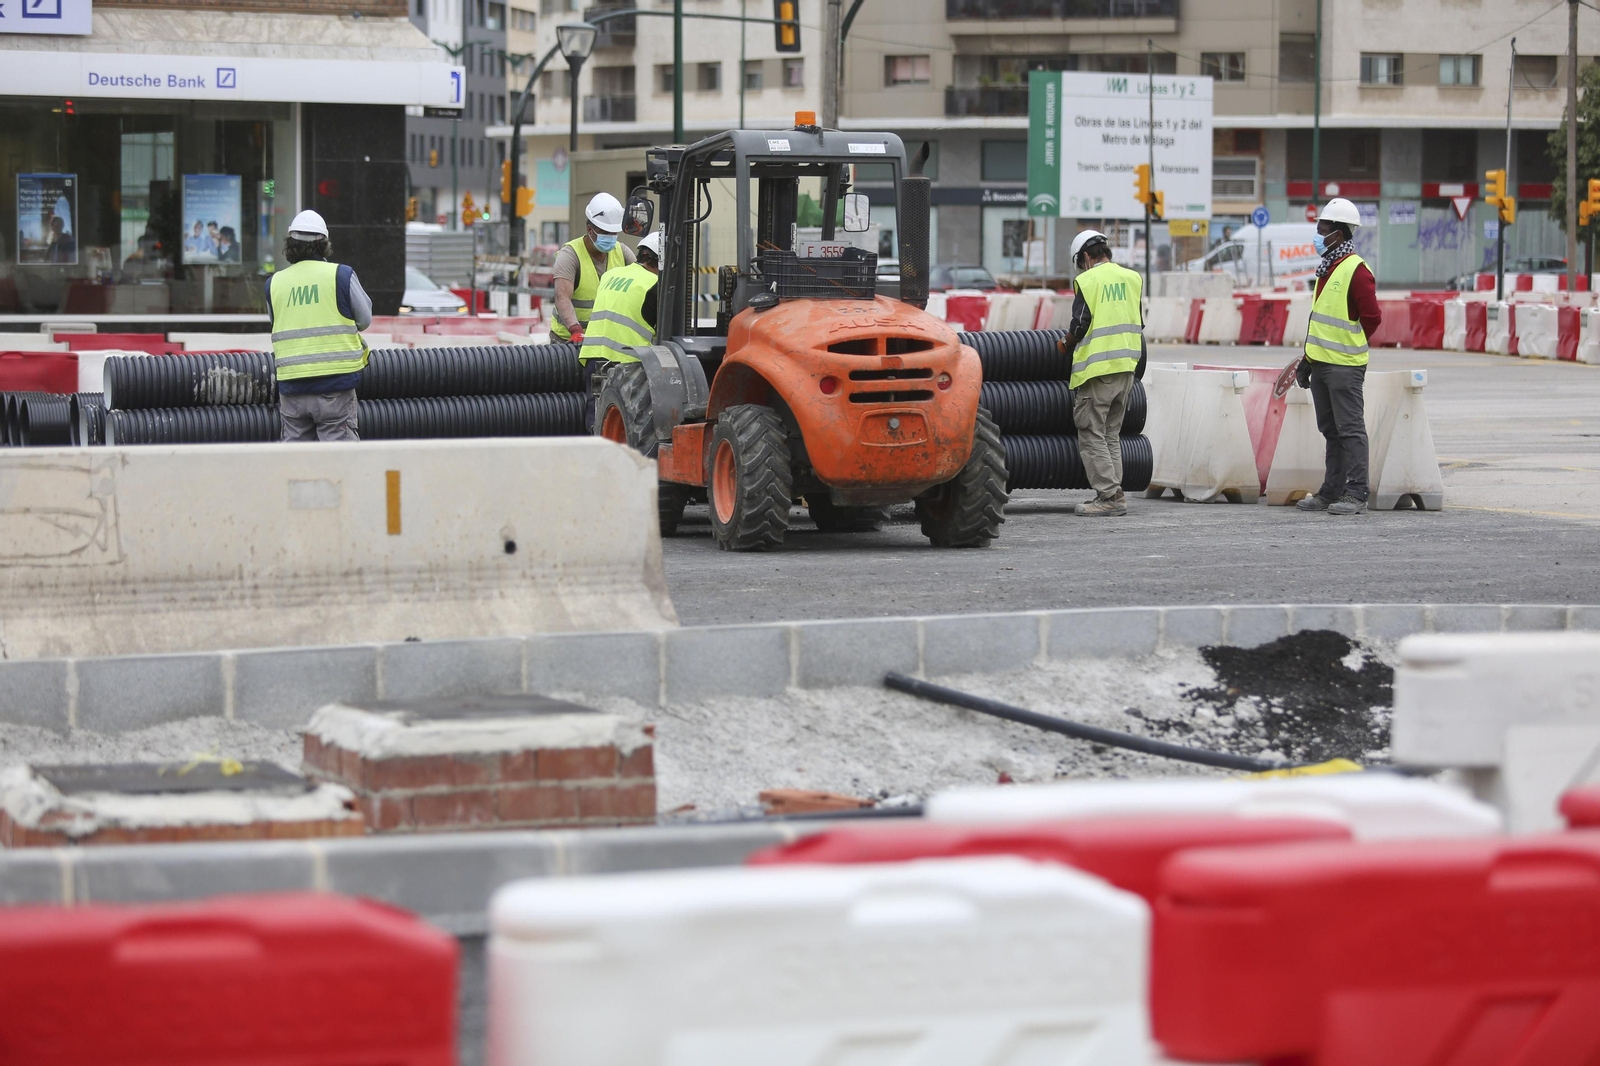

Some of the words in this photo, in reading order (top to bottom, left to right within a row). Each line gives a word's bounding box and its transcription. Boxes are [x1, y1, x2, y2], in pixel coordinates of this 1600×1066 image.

[88, 72, 162, 87] Deutsche
[167, 74, 206, 89] Bank
[1074, 115, 1103, 128] Obras
[1104, 116, 1115, 128] de
[1117, 116, 1131, 129] las
[1181, 117, 1187, 130] 2
[1188, 118, 1202, 131] del
[1101, 133, 1128, 146] Metro
[1130, 134, 1141, 146] de
[829, 317, 925, 334] AUSA
